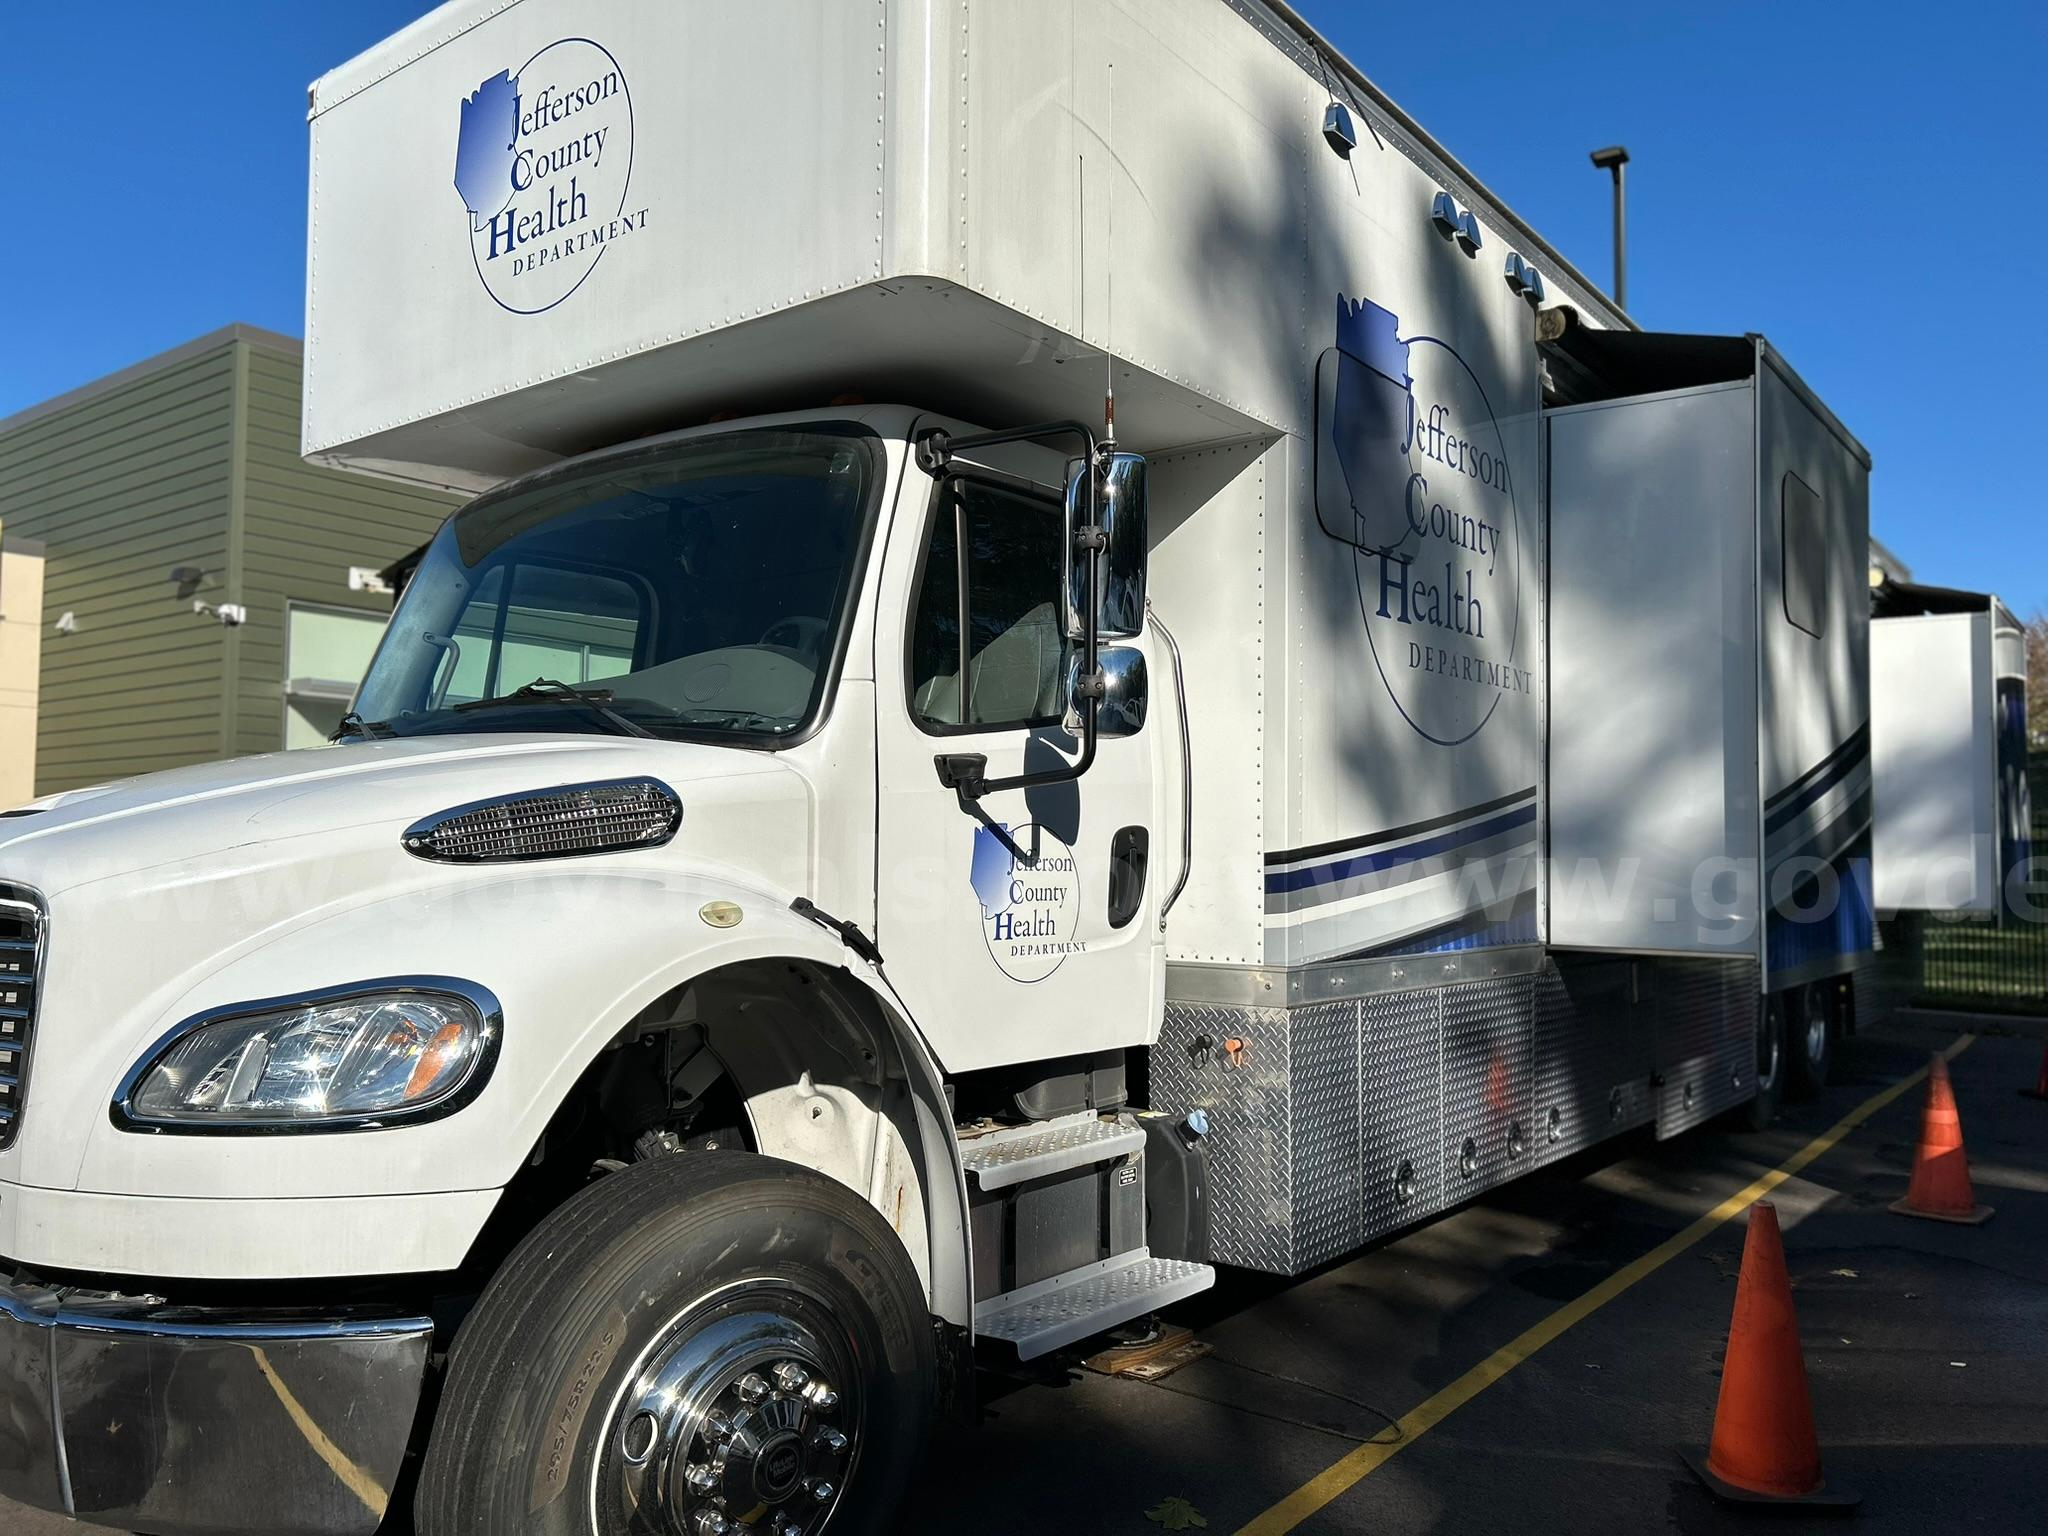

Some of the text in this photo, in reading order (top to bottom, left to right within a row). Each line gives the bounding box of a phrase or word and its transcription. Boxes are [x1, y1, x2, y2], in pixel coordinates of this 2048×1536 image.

[507, 71, 619, 151] Jefferson
[510, 126, 609, 192] County
[486, 176, 588, 261] Health
[512, 208, 649, 277] DEPARTMENT
[1400, 373, 1508, 495] Jefferson
[1405, 472, 1501, 576] County
[1376, 545, 1485, 639] Health
[1408, 641, 1533, 696] DEPARTMENT
[993, 909, 1056, 941] Health
[1009, 879, 1068, 909] County
[1011, 941, 1087, 957] DEPARTMENT
